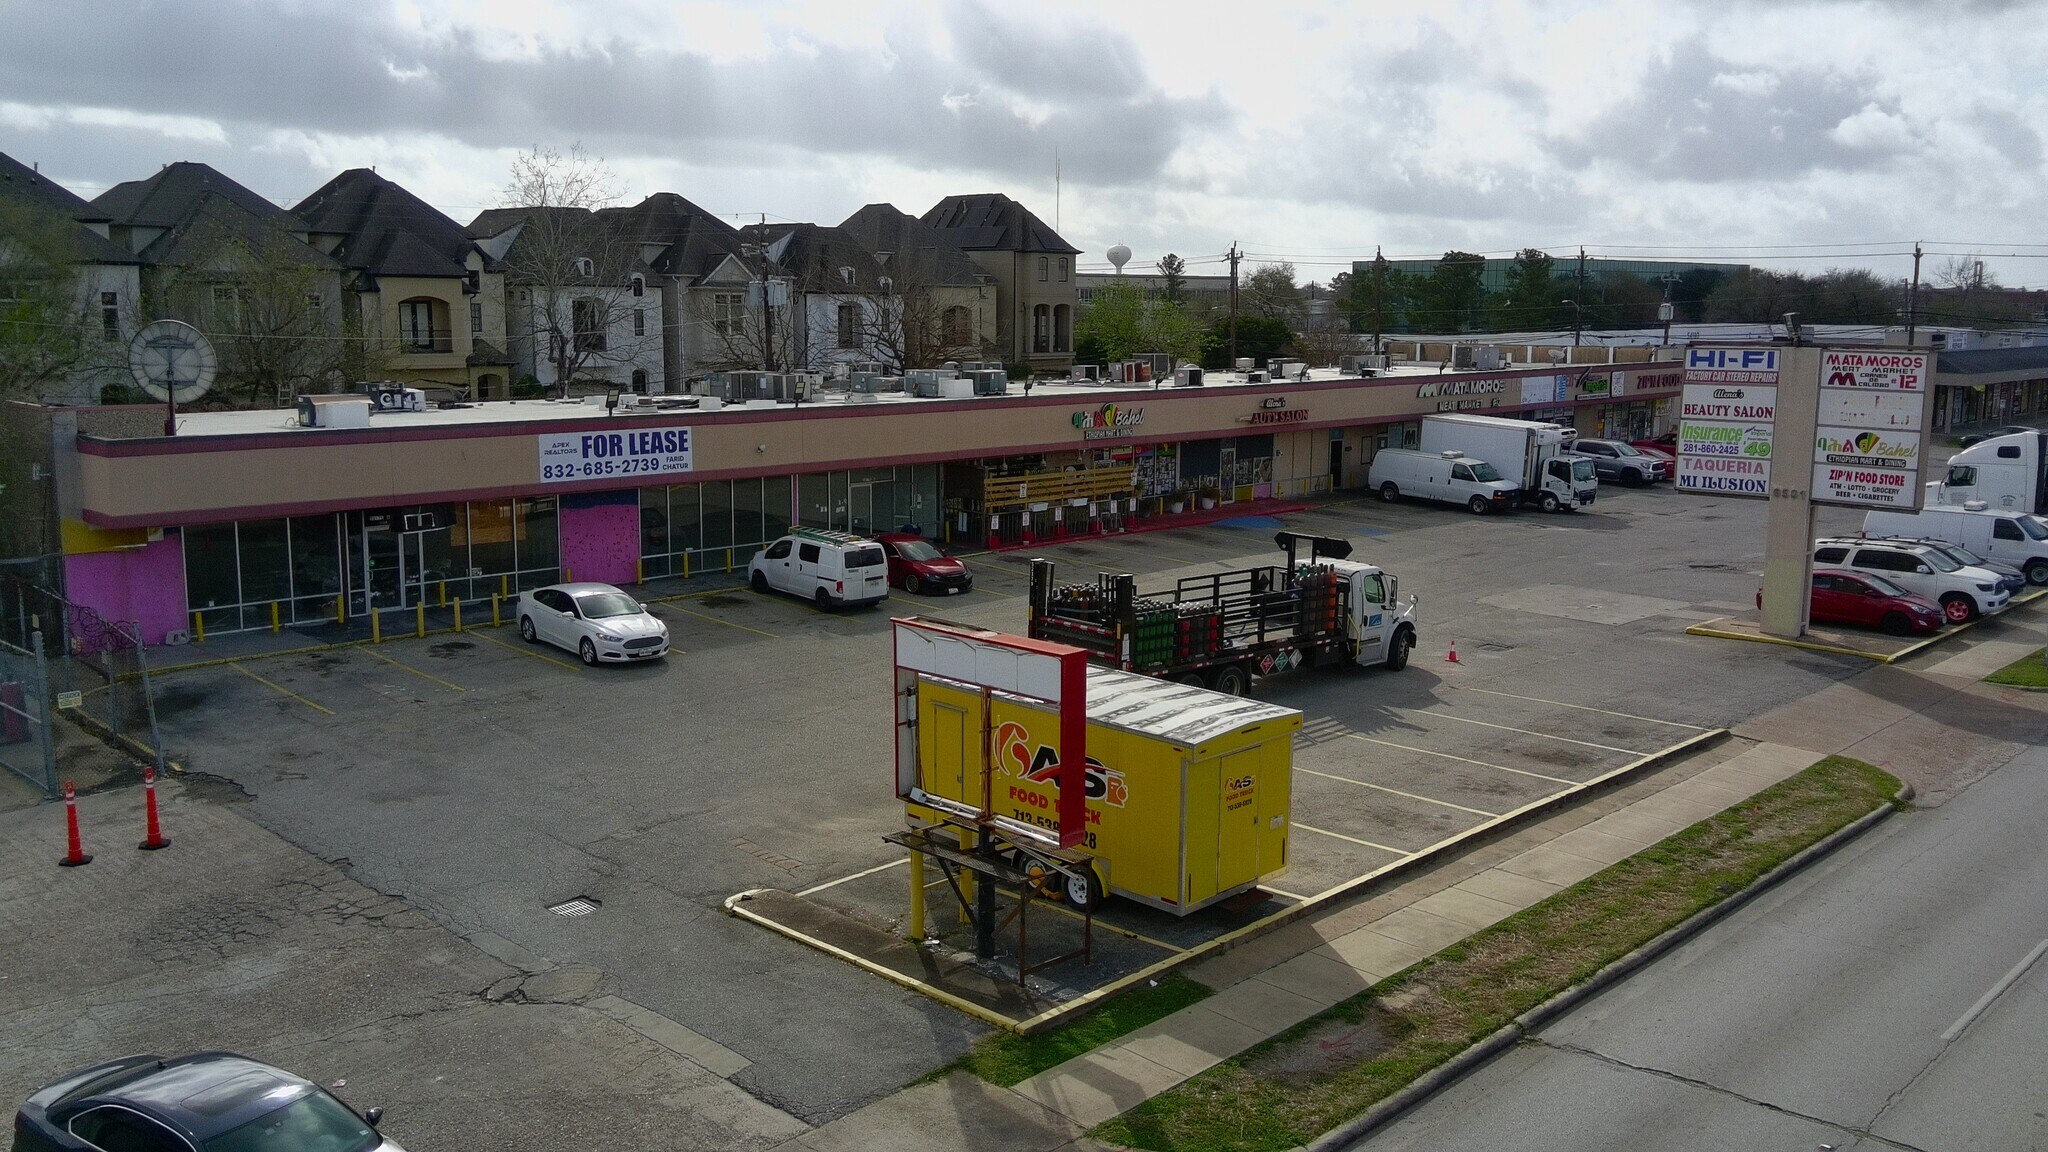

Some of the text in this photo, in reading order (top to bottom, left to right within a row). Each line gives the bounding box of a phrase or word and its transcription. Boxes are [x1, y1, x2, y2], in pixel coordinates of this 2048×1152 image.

[1690, 350, 1775, 368] HI-FI
[1686, 371, 1777, 382] FACTORY CAR STEREO REPAIRS
[1714, 389, 1744, 398] Alena's
[1279, 409, 1309, 422] SALON
[1684, 404, 1731, 416] BEAUTY
[1734, 406, 1773, 418] SALON
[1681, 422, 1743, 441] Insurance
[582, 430, 689, 458] FOR LEASE
[1683, 444, 1739, 454] 281-860-2425
[1877, 442, 1917, 458] Bahel
[543, 458, 659, 479] 832-685-2739
[1683, 458, 1764, 474] TAQUERIA
[1828, 455, 1858, 464] ETHIOPIAN
[1859, 457, 1876, 465] MART
[1885, 458, 1906, 468] DINING
[1679, 475, 1767, 492] MI ILUSION
[1829, 469, 1905, 486] ZIP'N FOOD STORE
[1858, 493, 1894, 502] CIGARETTES
[1872, 487, 1900, 495] GROCERY
[1009, 786, 1048, 809] FOOD
